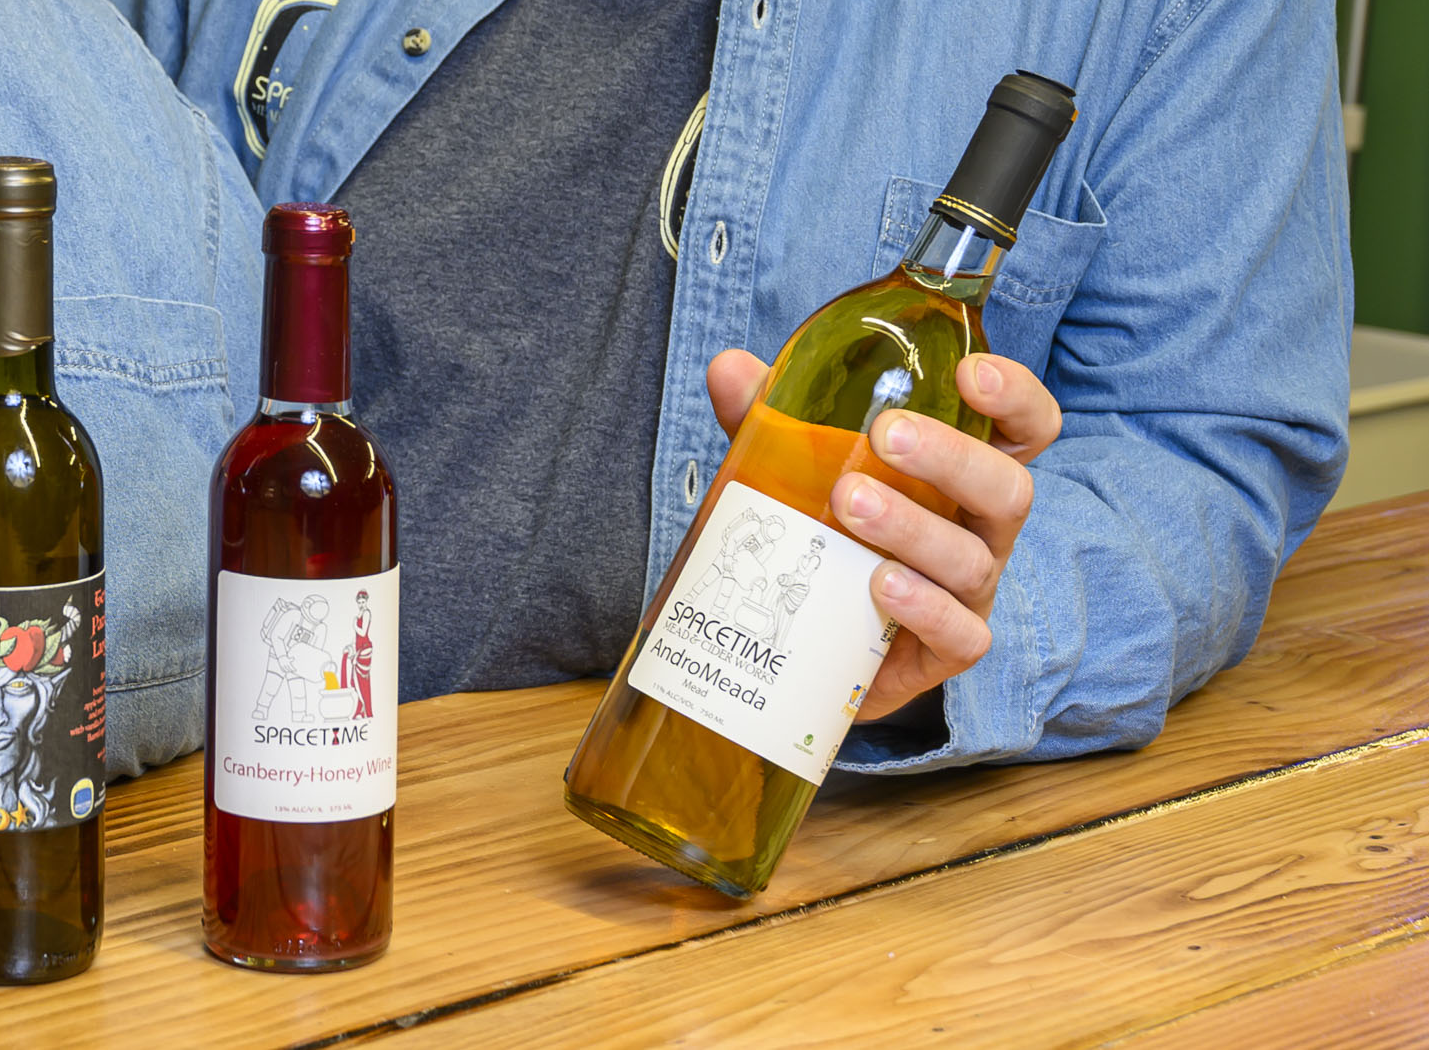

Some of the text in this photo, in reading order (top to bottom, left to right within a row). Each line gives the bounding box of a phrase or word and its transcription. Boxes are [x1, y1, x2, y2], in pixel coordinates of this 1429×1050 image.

[663, 620, 777, 686] MEAD & CIDER WORKS
[668, 601, 787, 675] SPACETIME
[650, 637, 767, 711] AndroMeada
[681, 678, 709, 698] Mead
[254, 723, 369, 746] SPACETIME
[223, 756, 392, 787] Cranberry-Honey Wine
